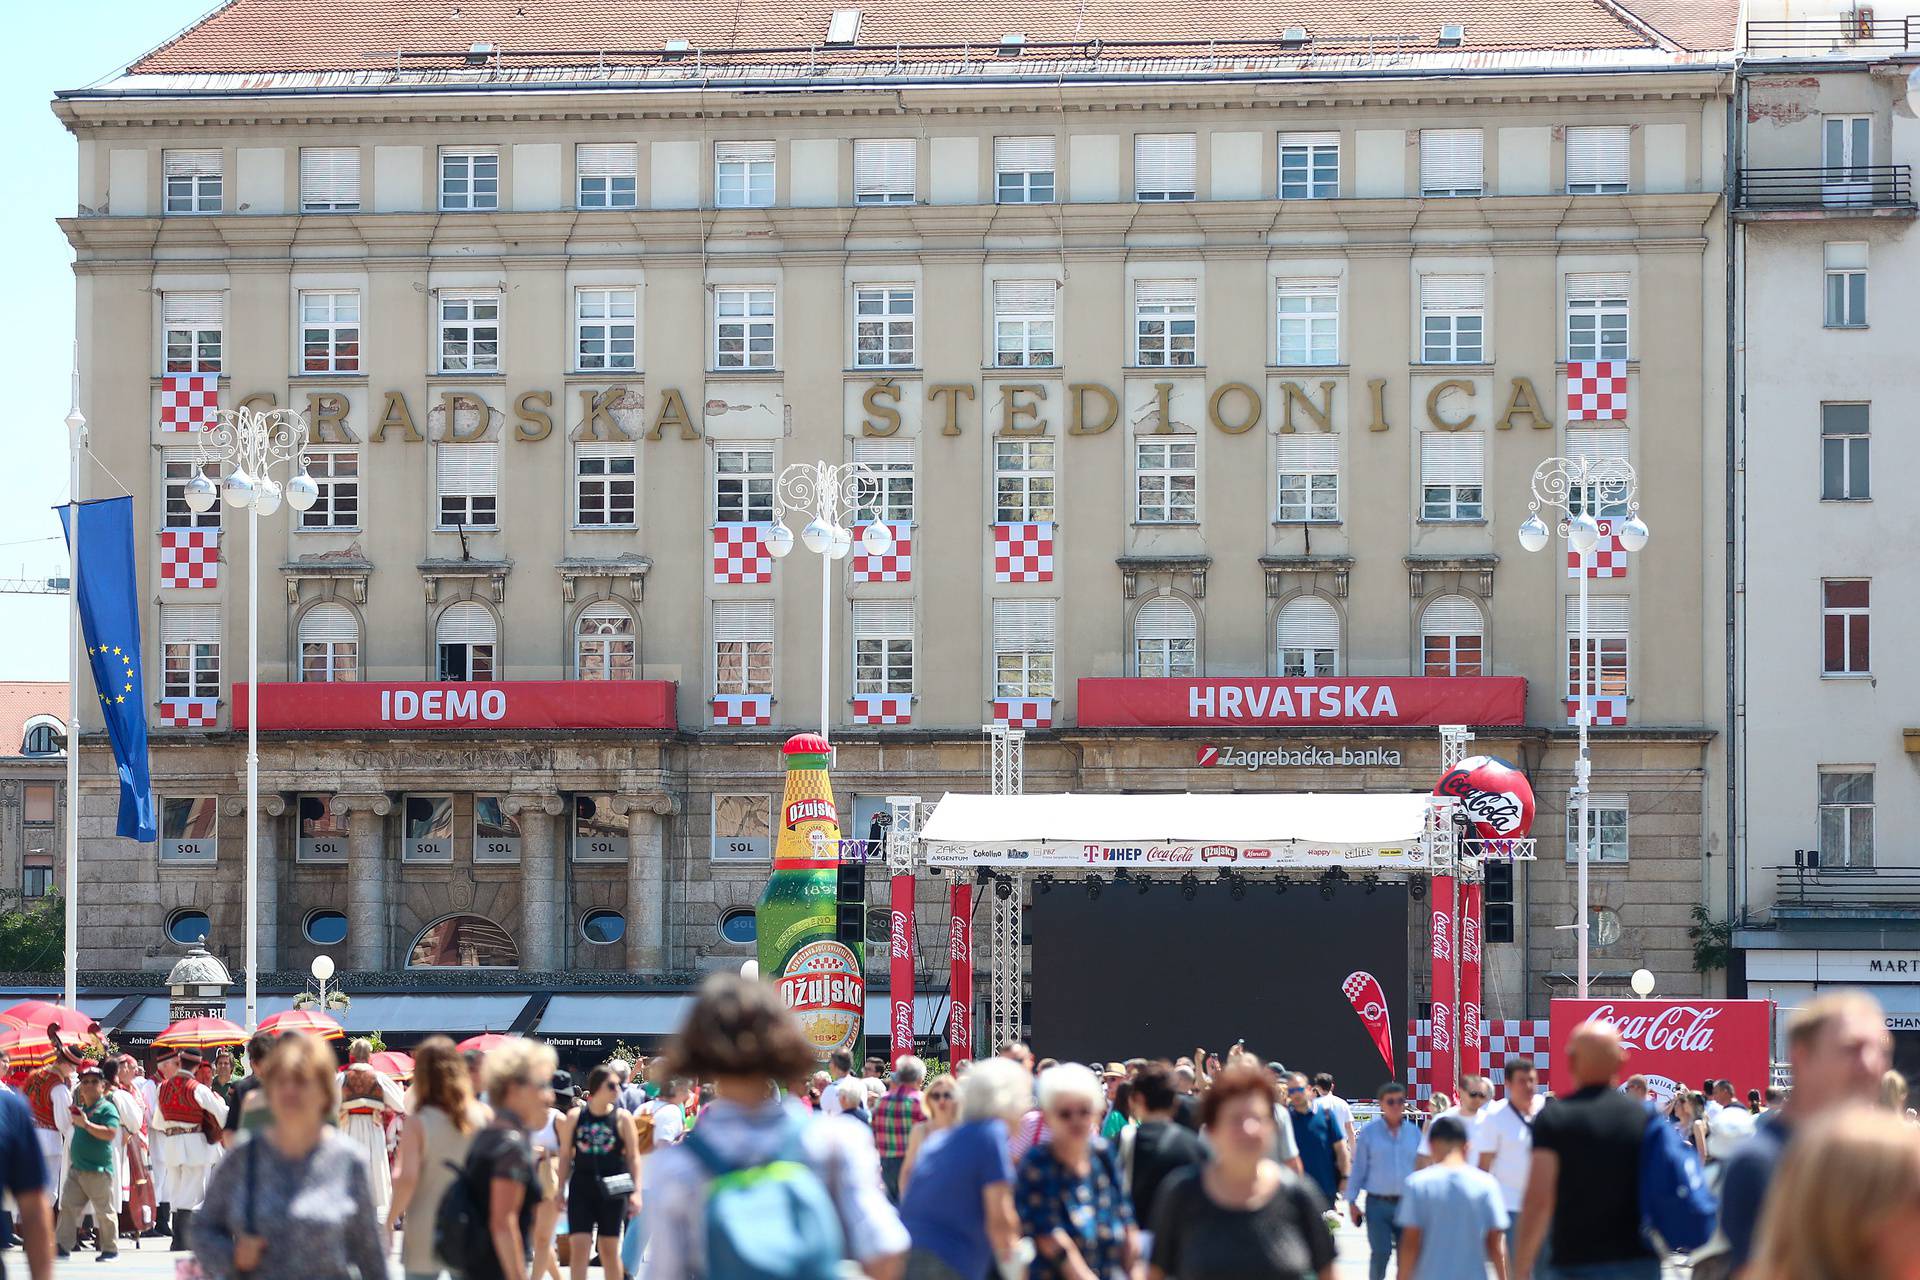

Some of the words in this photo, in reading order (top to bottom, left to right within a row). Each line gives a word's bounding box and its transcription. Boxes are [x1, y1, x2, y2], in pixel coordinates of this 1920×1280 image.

[863, 377, 1553, 437] ŠTEDIONICA
[381, 689, 506, 721] IDEMO
[1188, 685, 1399, 718] HRVATSKA
[1222, 745, 1334, 771] Zagrebačka
[1341, 746, 1402, 766] banka
[177, 844, 201, 854] SOL
[314, 843, 338, 853] SOL
[417, 843, 441, 853] SOL
[488, 843, 512, 853] SOL
[591, 843, 615, 853] SOL
[730, 842, 754, 852] SOL
[935, 845, 967, 855] ZAKS
[1116, 848, 1142, 861] HEP
[780, 974, 863, 1008] Ožujsko
[543, 1037, 574, 1046] Johann
[575, 1037, 602, 1046] Franck
